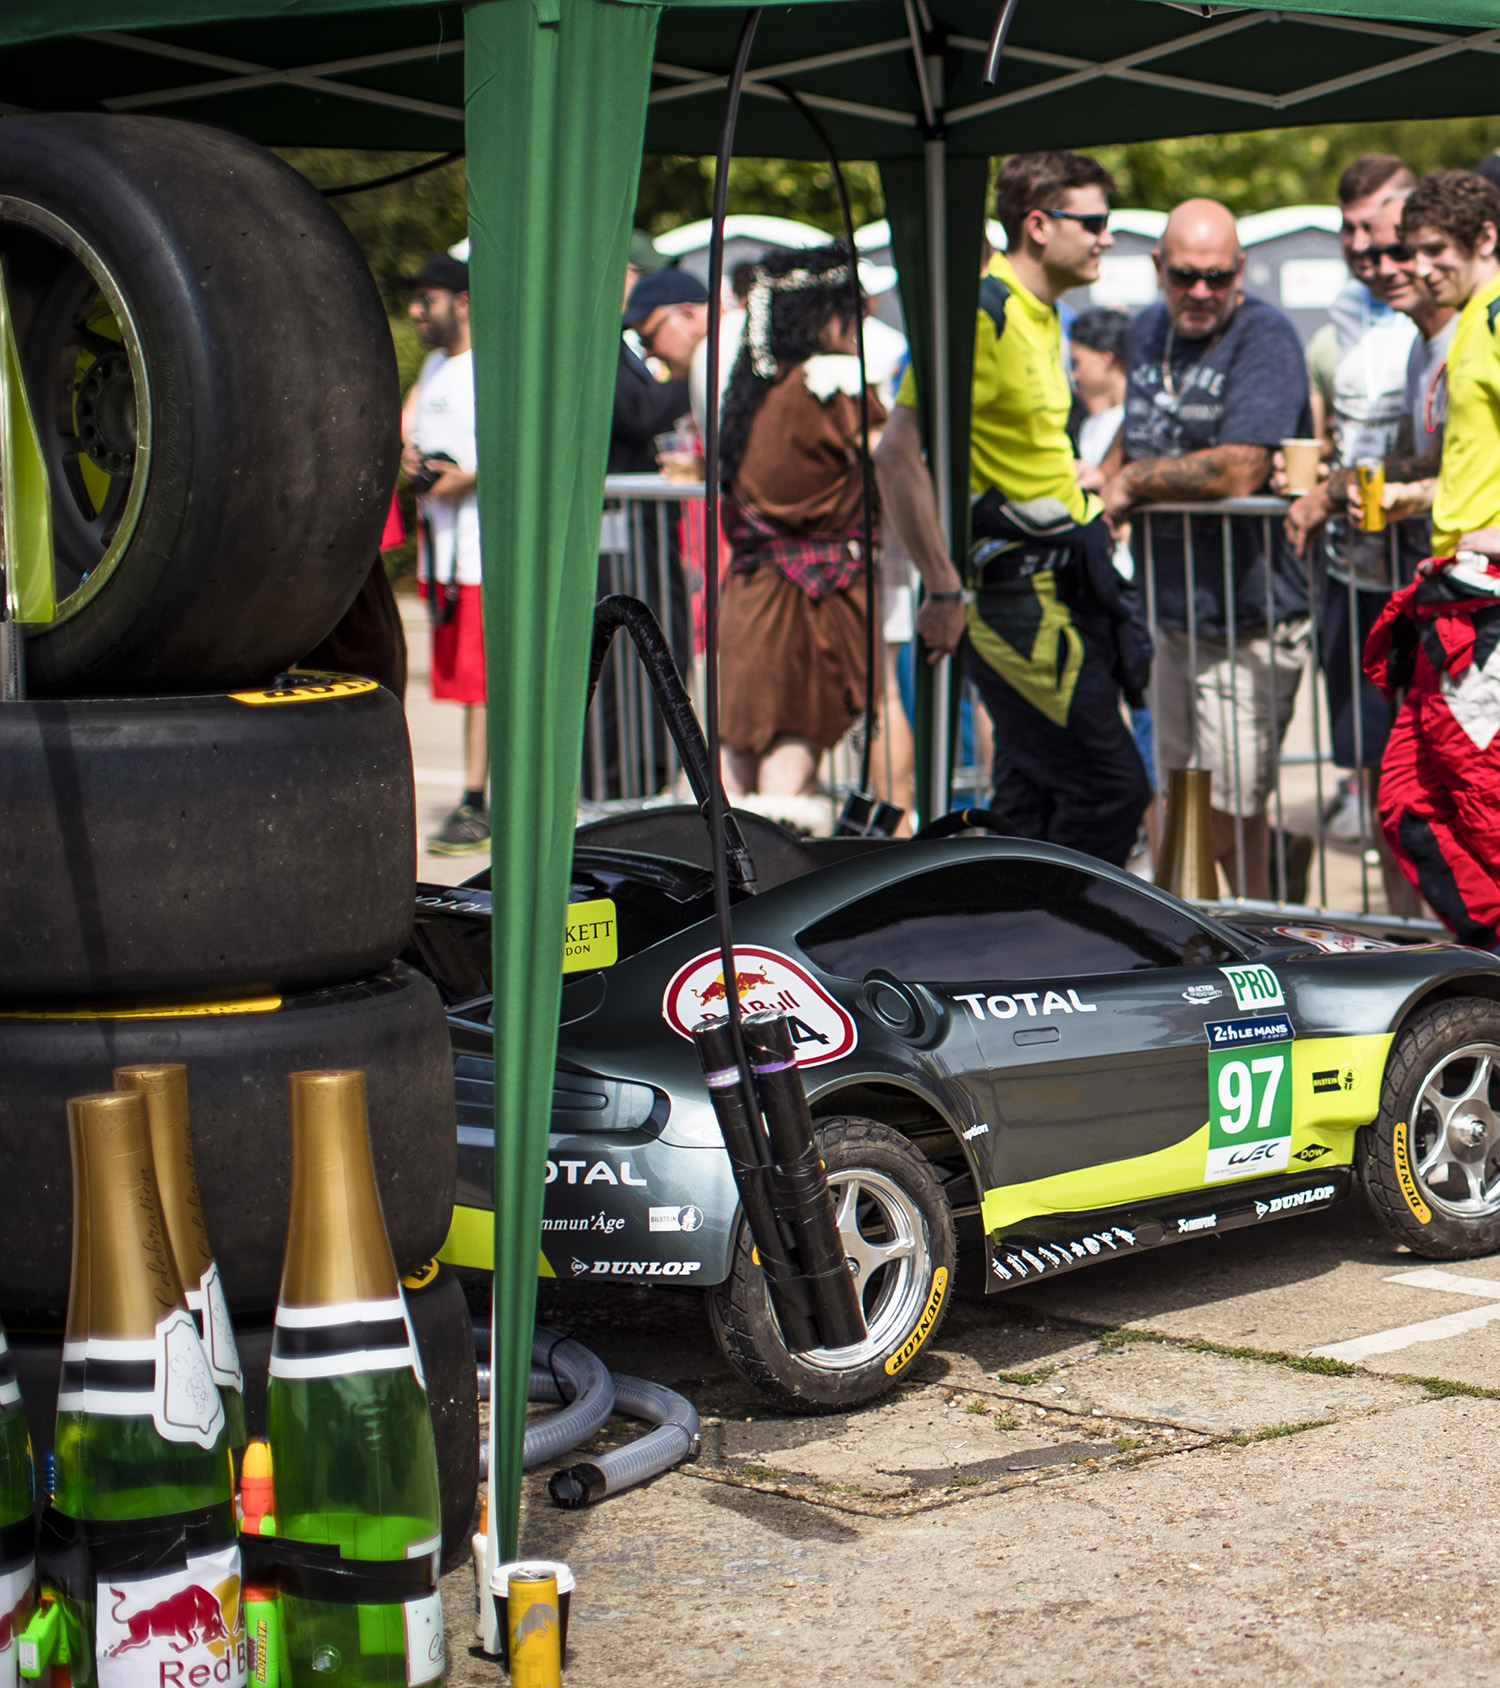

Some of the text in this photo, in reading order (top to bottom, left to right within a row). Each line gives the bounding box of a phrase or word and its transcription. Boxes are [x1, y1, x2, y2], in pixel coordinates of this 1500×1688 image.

[952, 979, 1098, 1021] TOTAL
[1229, 968, 1278, 1002] PRO
[1238, 1029, 1253, 1039] LE
[1254, 1023, 1289, 1037] MANS
[1217, 1055, 1285, 1135] 97
[1313, 1077, 1338, 1088] BILSTEIN
[1227, 1142, 1281, 1166] WEC
[1300, 1147, 1326, 1160] DOW
[1397, 1130, 1422, 1208] DUNLOP
[1268, 1185, 1335, 1213] DUNLOP
[650, 1214, 677, 1224] BILSTEIN
[590, 1261, 701, 1276] DUNLOP
[892, 1287, 943, 1371] DUNLOP
[159, 1646, 231, 1688] Red
[256, 1618, 269, 1685] WATERZONE
